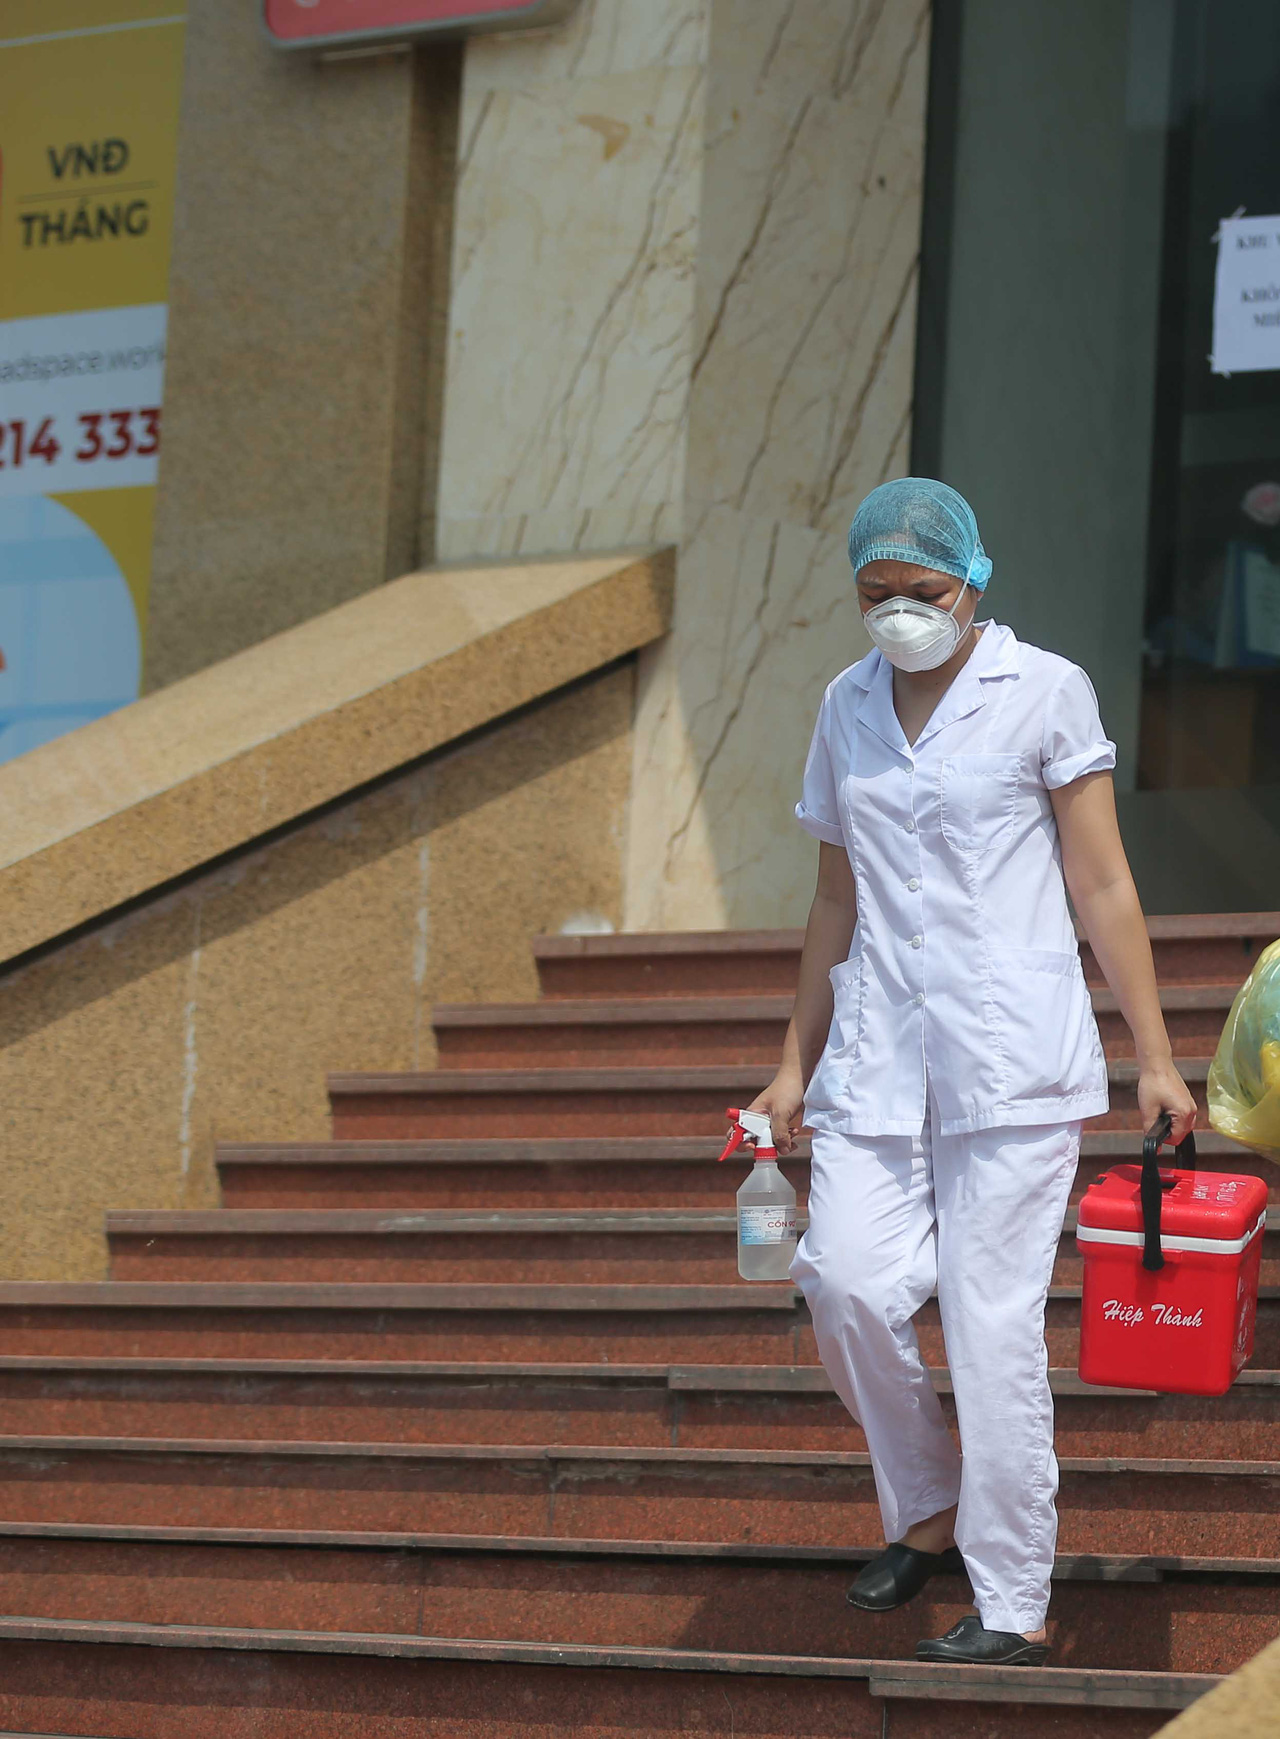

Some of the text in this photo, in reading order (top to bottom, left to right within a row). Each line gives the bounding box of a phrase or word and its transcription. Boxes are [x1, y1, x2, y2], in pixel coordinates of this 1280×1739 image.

[48, 137, 129, 180] VNĐ
[19, 197, 149, 248] THÁNG
[75, 407, 161, 462] 333
[1102, 1299, 1203, 1328] Hiệp Thành
